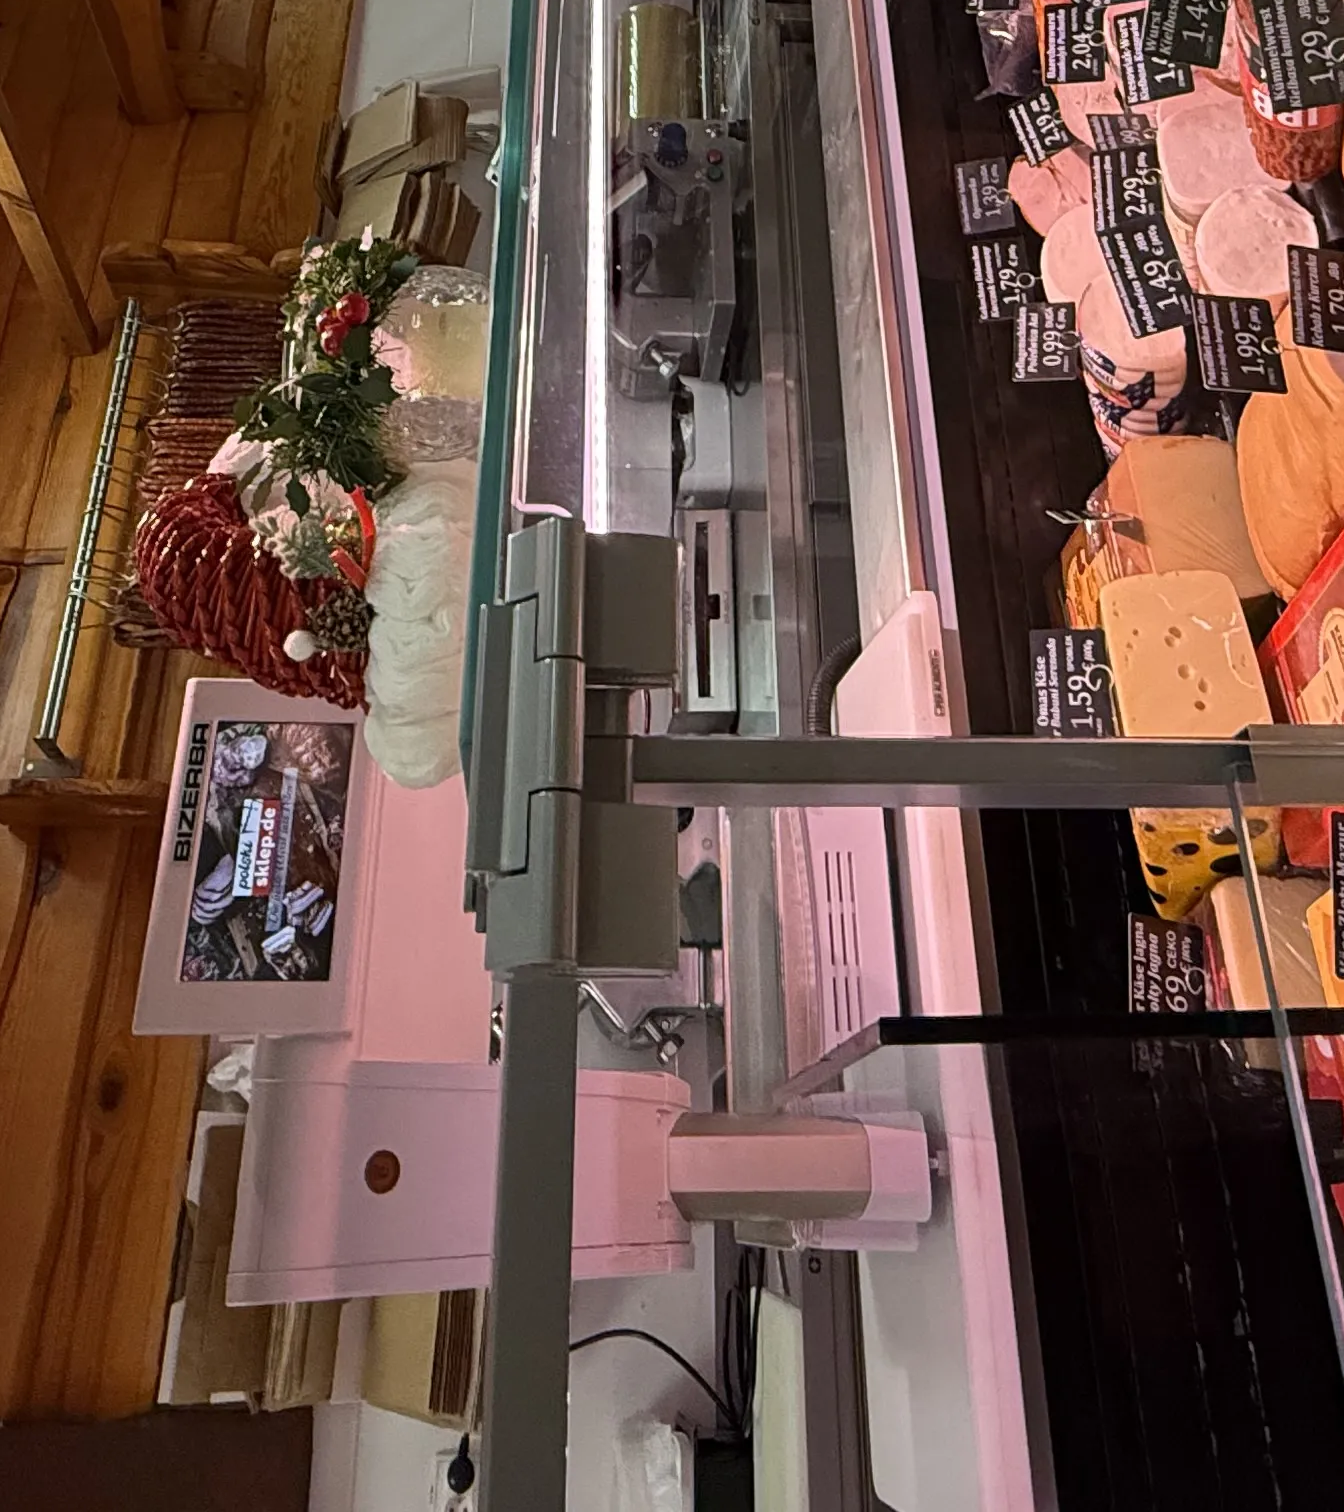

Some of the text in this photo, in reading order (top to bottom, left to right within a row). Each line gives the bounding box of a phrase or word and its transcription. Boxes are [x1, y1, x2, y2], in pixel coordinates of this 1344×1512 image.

[1071, 32, 1093, 70] 2,04
[1144, 10, 1162, 52] Wurst
[1258, 6, 1289, 102] Kümmelwurst
[1300, 29, 1336, 86] 1,29
[1282, 59, 1304, 108] Kielbasa
[1036, 114, 1061, 146] 2,19
[981, 185, 1002, 217] 1,39
[1122, 177, 1147, 217] 2,29
[998, 268, 1021, 304] 1,79
[1143, 260, 1180, 310] 1,49
[1042, 331, 1063, 366] 0,99
[1234, 332, 1265, 375] 1,99
[1309, 312, 1324, 347] Kebab
[1035, 656, 1049, 727] Omas Käse
[1067, 674, 1095, 729] 1,59
[173, 723, 209, 862] BIZERBA
[238, 840, 254, 889] polski
[254, 807, 277, 886] sklep.de
[1133, 922, 1147, 1000] Käse Jagna
[1146, 933, 1162, 1012] olty Jagna
